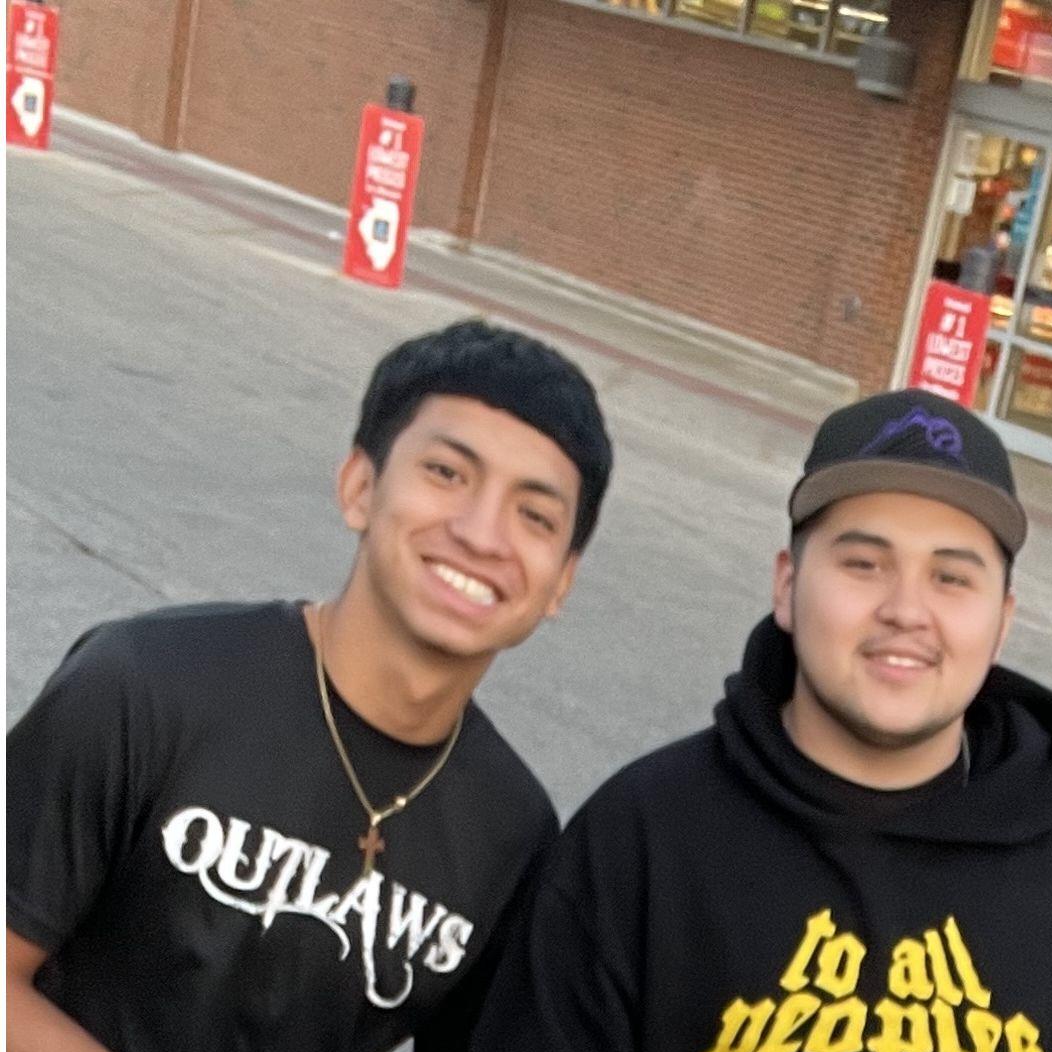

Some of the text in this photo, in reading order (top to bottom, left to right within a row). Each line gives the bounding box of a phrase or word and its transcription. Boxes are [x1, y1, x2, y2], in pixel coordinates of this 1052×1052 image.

[161, 805, 475, 1009] OUTLAWS
[779, 907, 992, 1009] to all
